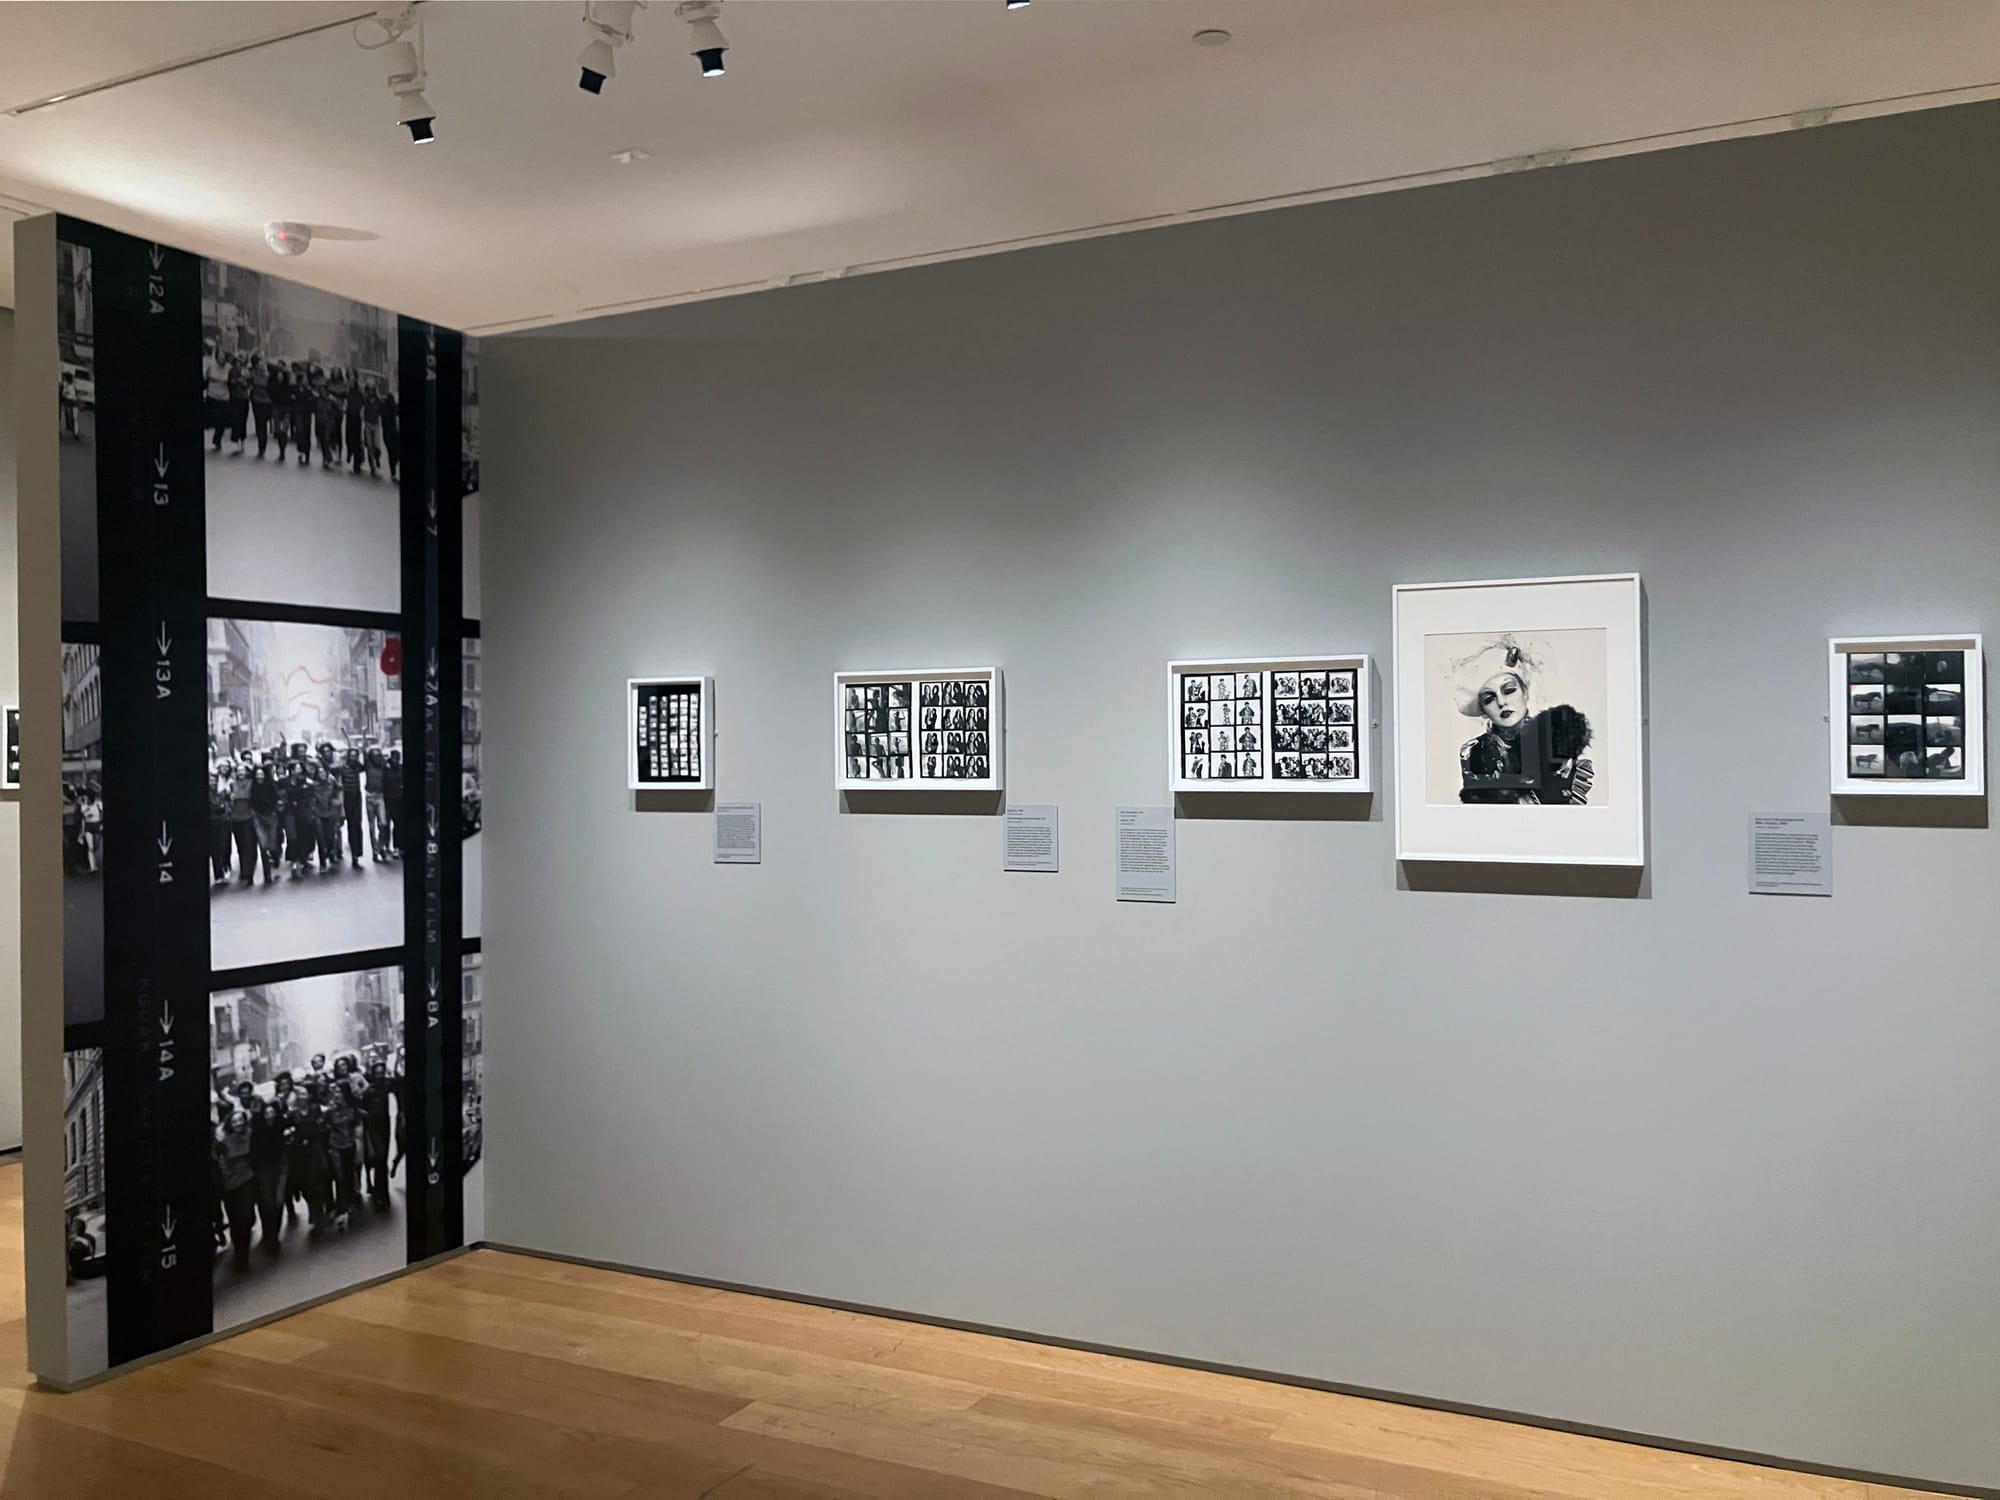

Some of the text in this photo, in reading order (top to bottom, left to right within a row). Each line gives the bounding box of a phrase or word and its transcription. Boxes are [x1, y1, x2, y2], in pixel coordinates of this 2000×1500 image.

[149, 275, 165, 314] 12A
[153, 484, 169, 505] 13
[155, 659, 171, 700] 13A
[157, 860, 173, 885] 14
[427, 1000, 439, 1028] 8A
[158, 1039, 174, 1082] 14A
[160, 1243, 176, 1269] 15
